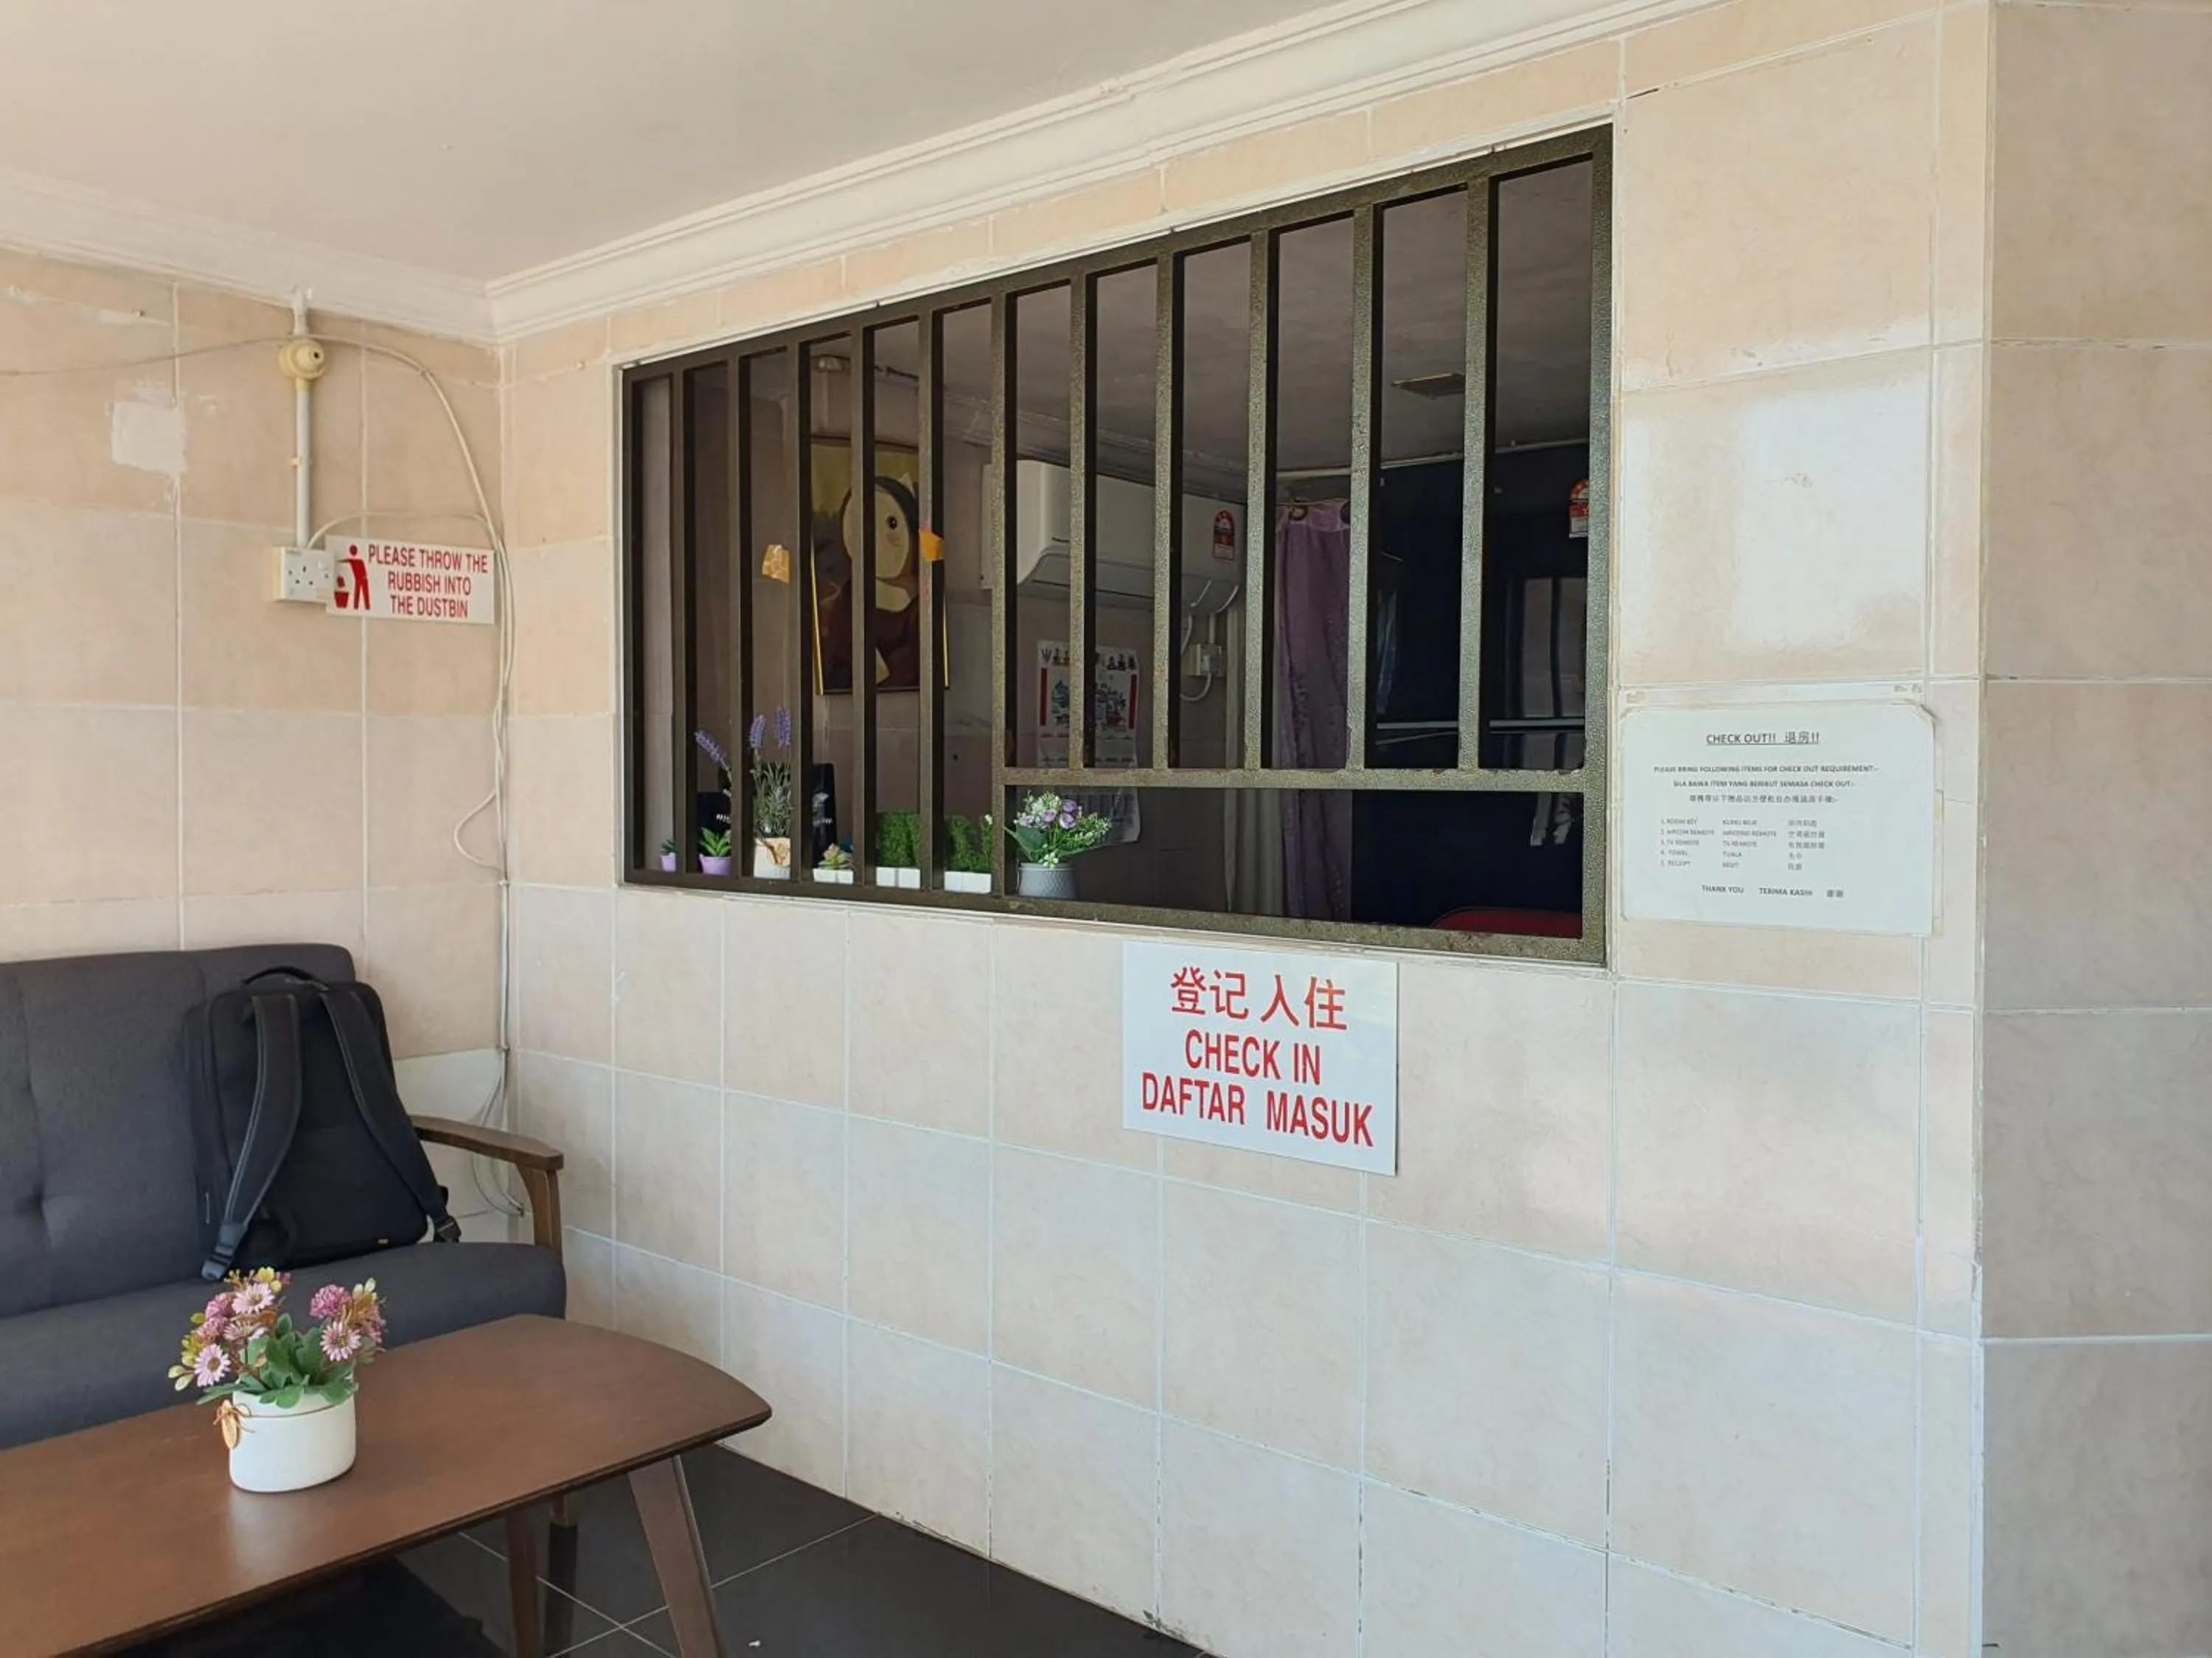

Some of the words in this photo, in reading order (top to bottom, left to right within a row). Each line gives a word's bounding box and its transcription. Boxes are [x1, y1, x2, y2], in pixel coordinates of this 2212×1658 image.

[368, 544, 416, 566] PLEASE
[419, 550, 462, 571] THROW
[467, 554, 488, 573] THE
[388, 571, 440, 593] RUBBISH
[445, 577, 471, 596] INTO
[390, 595, 413, 615] THE
[417, 597, 468, 619] DUSTBIN
[1705, 733, 1741, 743] CHECK
[1759, 887, 1787, 895] TERIMA
[1170, 966, 1347, 1030] 登记入住
[1185, 1029, 1281, 1081] CHECK
[1294, 1042, 1321, 1086] IN
[1141, 1072, 1245, 1125] DAFTAR
[1266, 1090, 1374, 1147] MASUK
